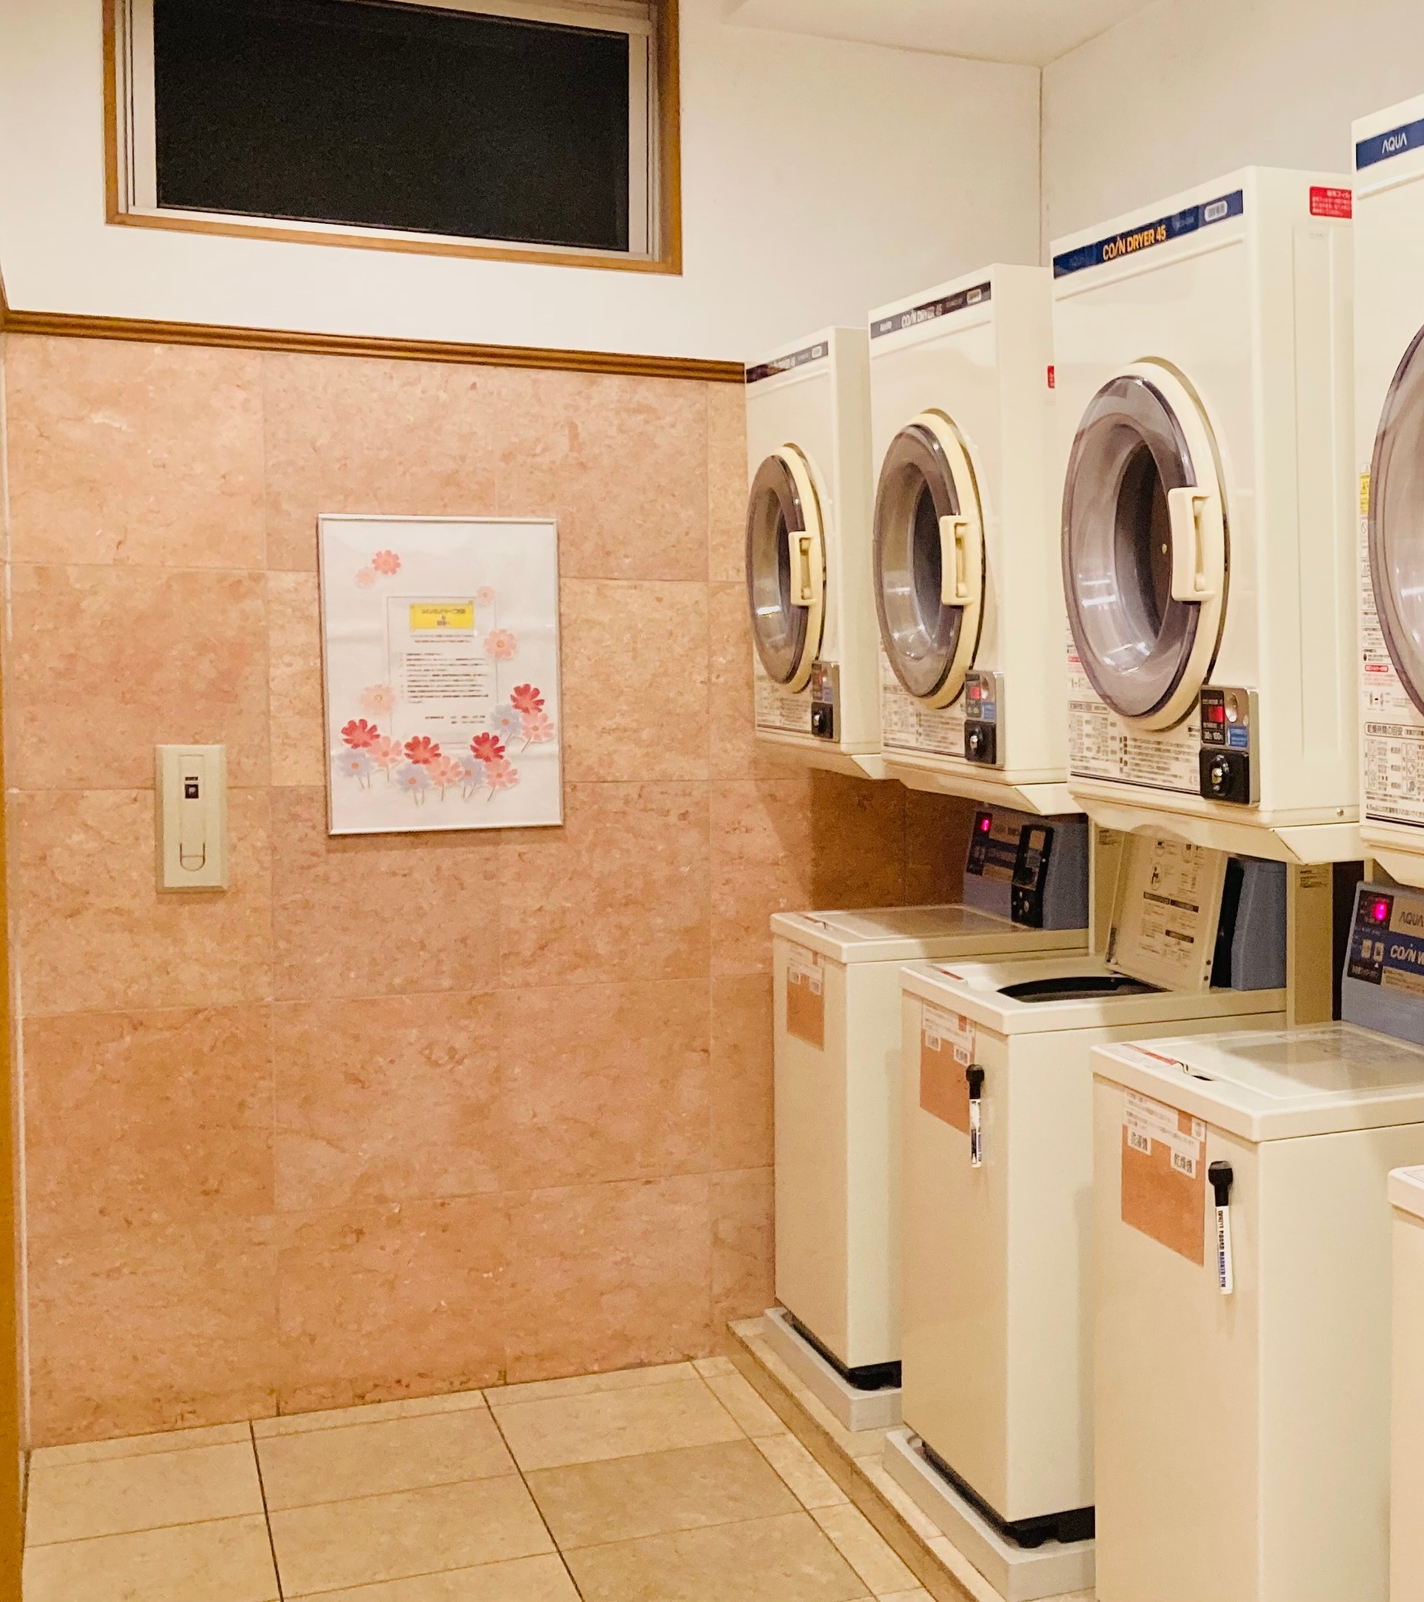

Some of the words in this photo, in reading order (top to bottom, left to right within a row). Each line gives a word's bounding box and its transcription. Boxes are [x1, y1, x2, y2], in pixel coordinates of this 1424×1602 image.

[1382, 132, 1408, 154] AQUA
[1127, 229, 1155, 251] DRYER
[1155, 225, 1167, 241] 45
[1398, 911, 1424, 928] AQUA
